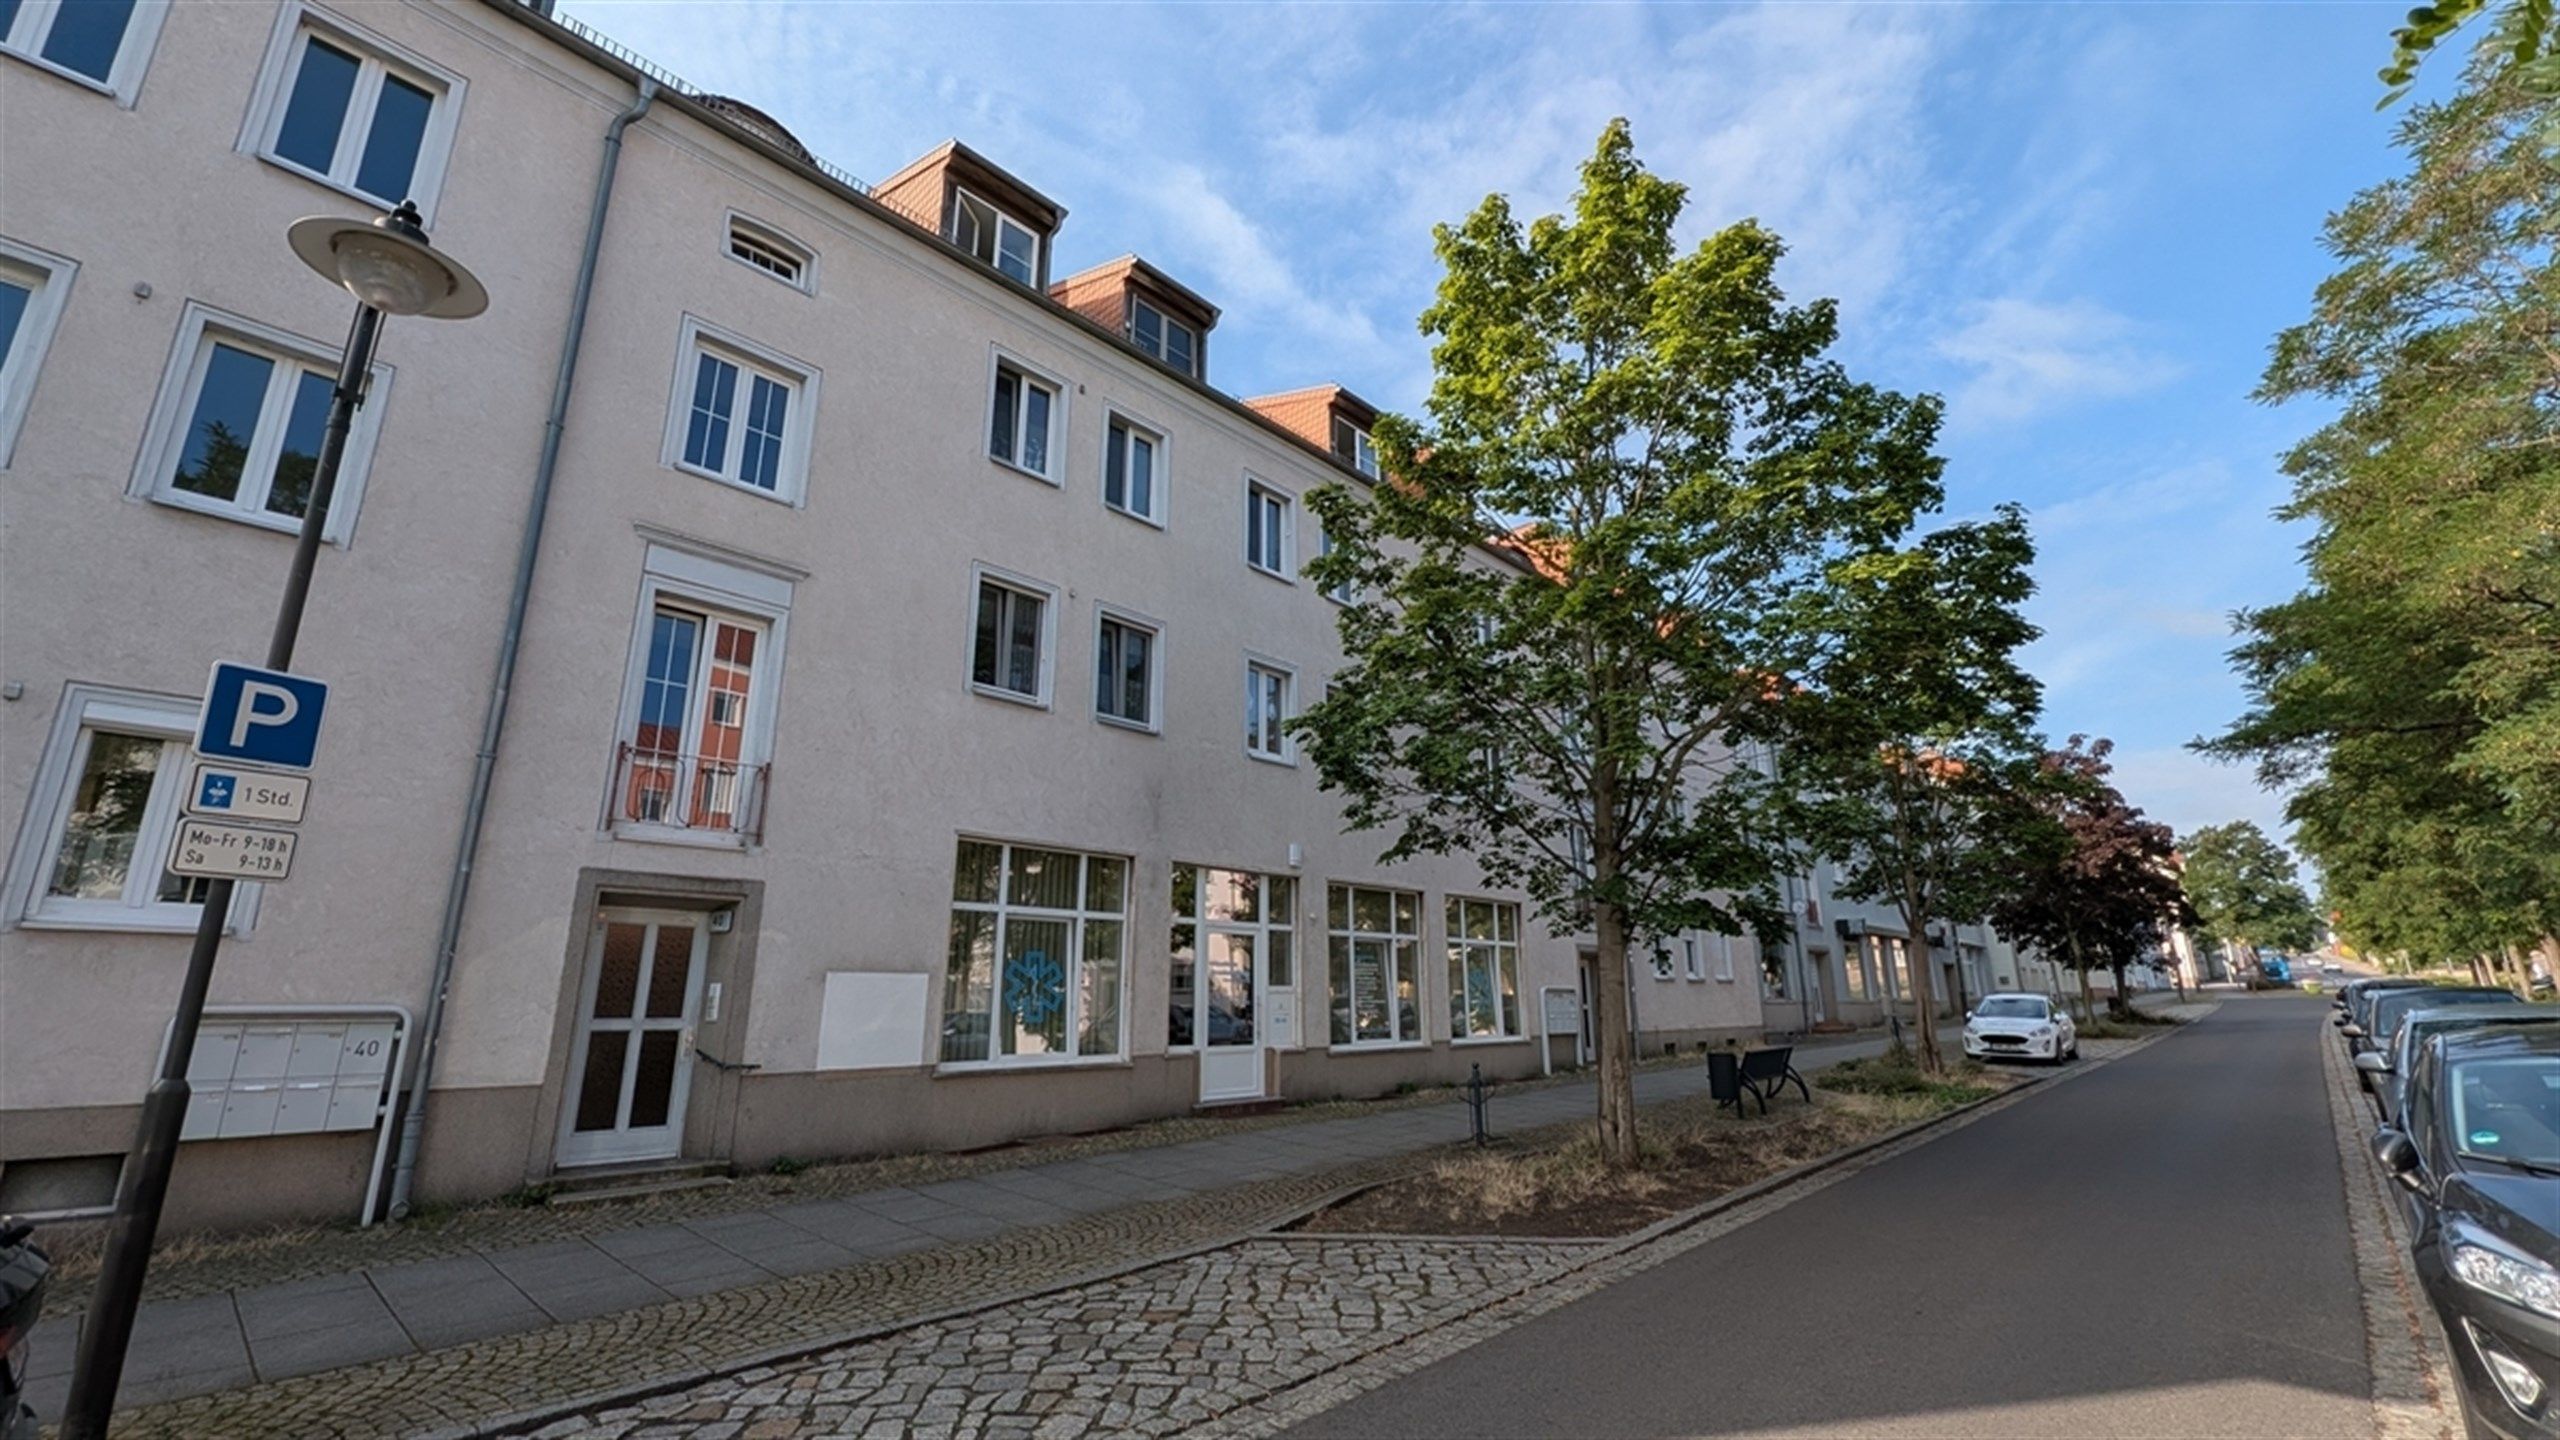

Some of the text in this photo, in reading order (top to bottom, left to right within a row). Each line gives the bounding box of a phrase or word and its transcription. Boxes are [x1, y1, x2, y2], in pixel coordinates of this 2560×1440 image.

[229, 680, 299, 747] P
[245, 787, 293, 807] 1 Std.
[189, 830, 287, 853] Mo-Fr 9-18 h
[185, 848, 283, 871] Sa 9-13 h
[354, 1040, 380, 1057] 40
